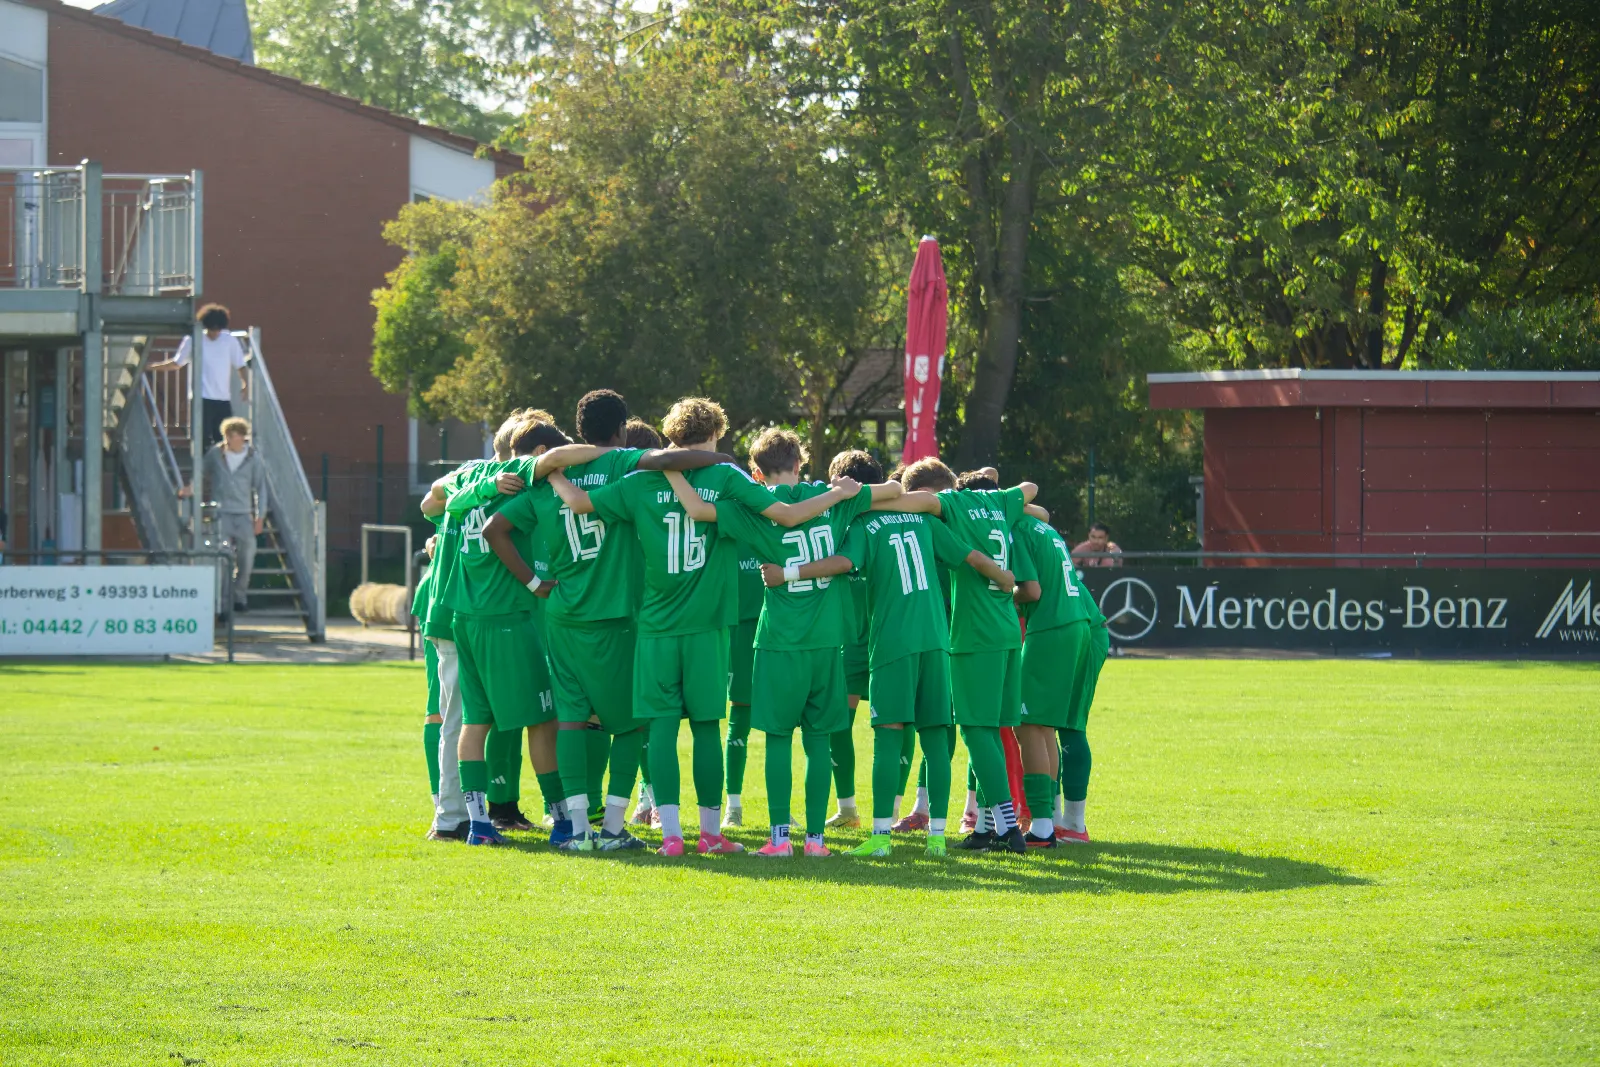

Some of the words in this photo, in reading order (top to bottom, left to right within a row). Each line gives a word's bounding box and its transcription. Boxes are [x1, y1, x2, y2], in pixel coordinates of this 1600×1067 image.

[657, 491, 672, 503] GW
[559, 503, 606, 562] 15
[663, 512, 706, 574] 16
[866, 519, 881, 535] GW
[879, 513, 924, 525] BROCKDORF
[782, 525, 835, 592] 20
[888, 530, 929, 595] 11
[70, 585, 80, 599] 3
[98, 585, 148, 599] 49393
[153, 586, 198, 599] Lohne
[1174, 585, 1508, 631] Mercedes-Benz
[23, 618, 83, 634] 04442
[105, 618, 128, 634] 80
[133, 618, 157, 634] 83
[162, 618, 198, 634] 460
